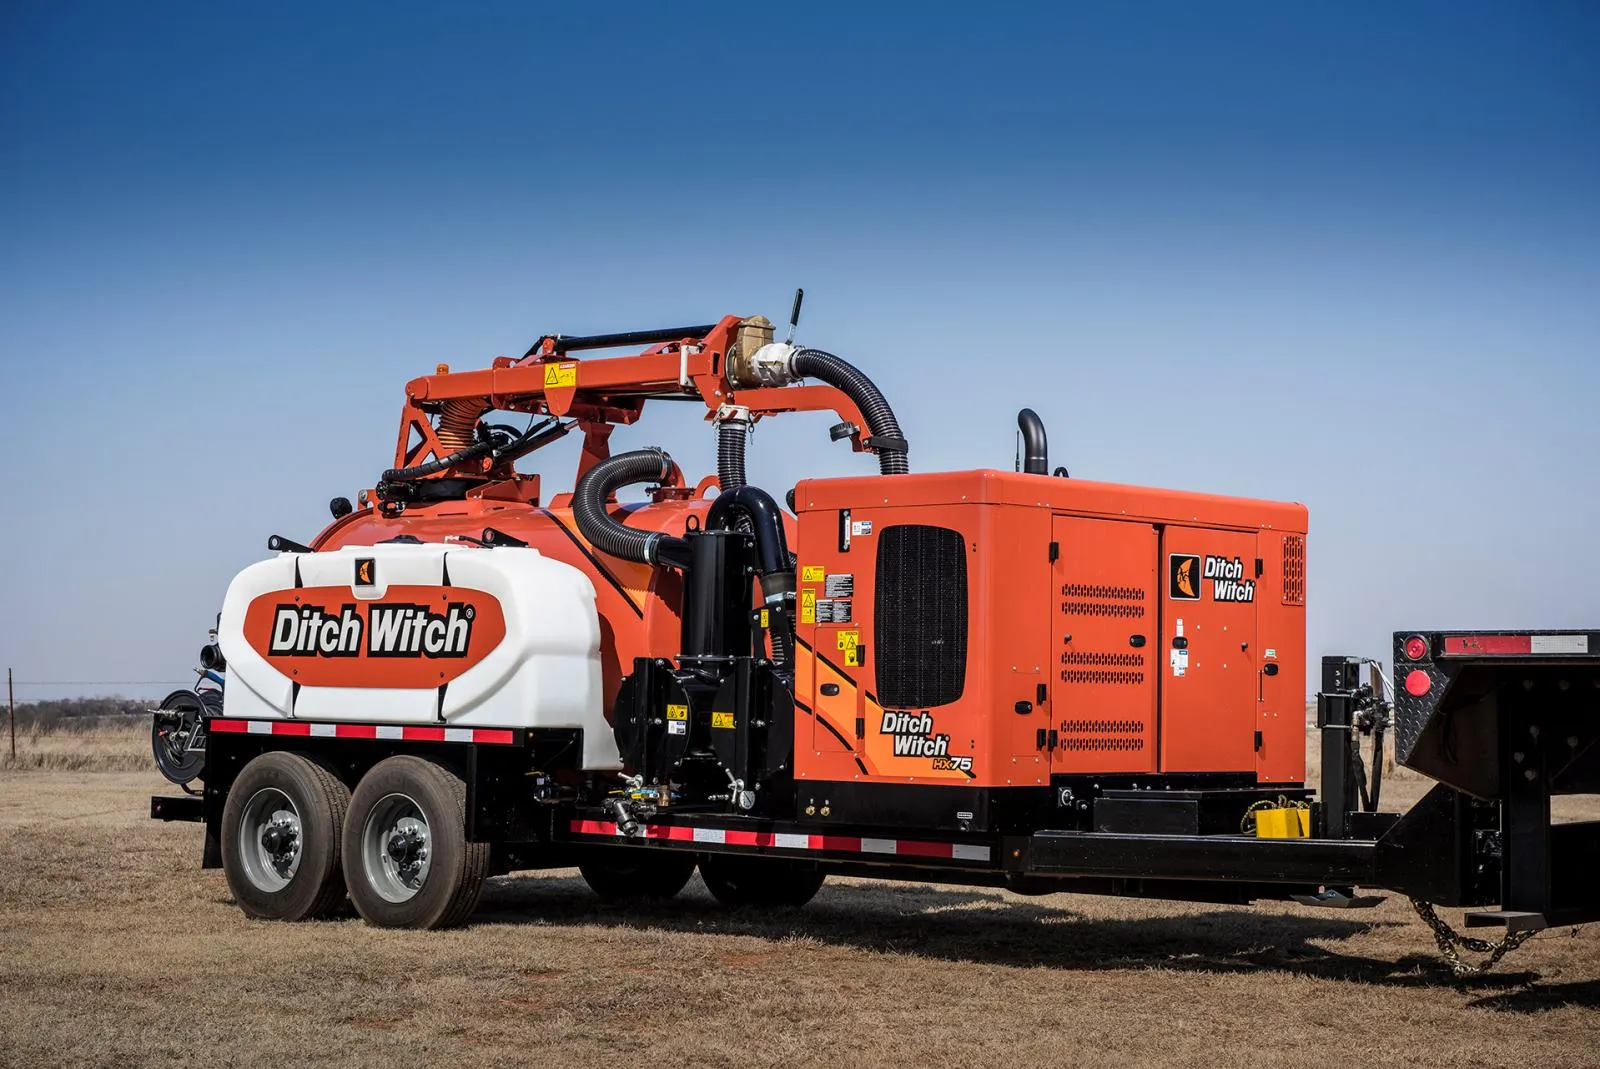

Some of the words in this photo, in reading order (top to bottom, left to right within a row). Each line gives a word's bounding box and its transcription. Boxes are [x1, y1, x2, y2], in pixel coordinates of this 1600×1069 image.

[1204, 557, 1242, 578] Ditch
[272, 609, 361, 652] Ditch
[882, 712, 932, 733] Ditch
